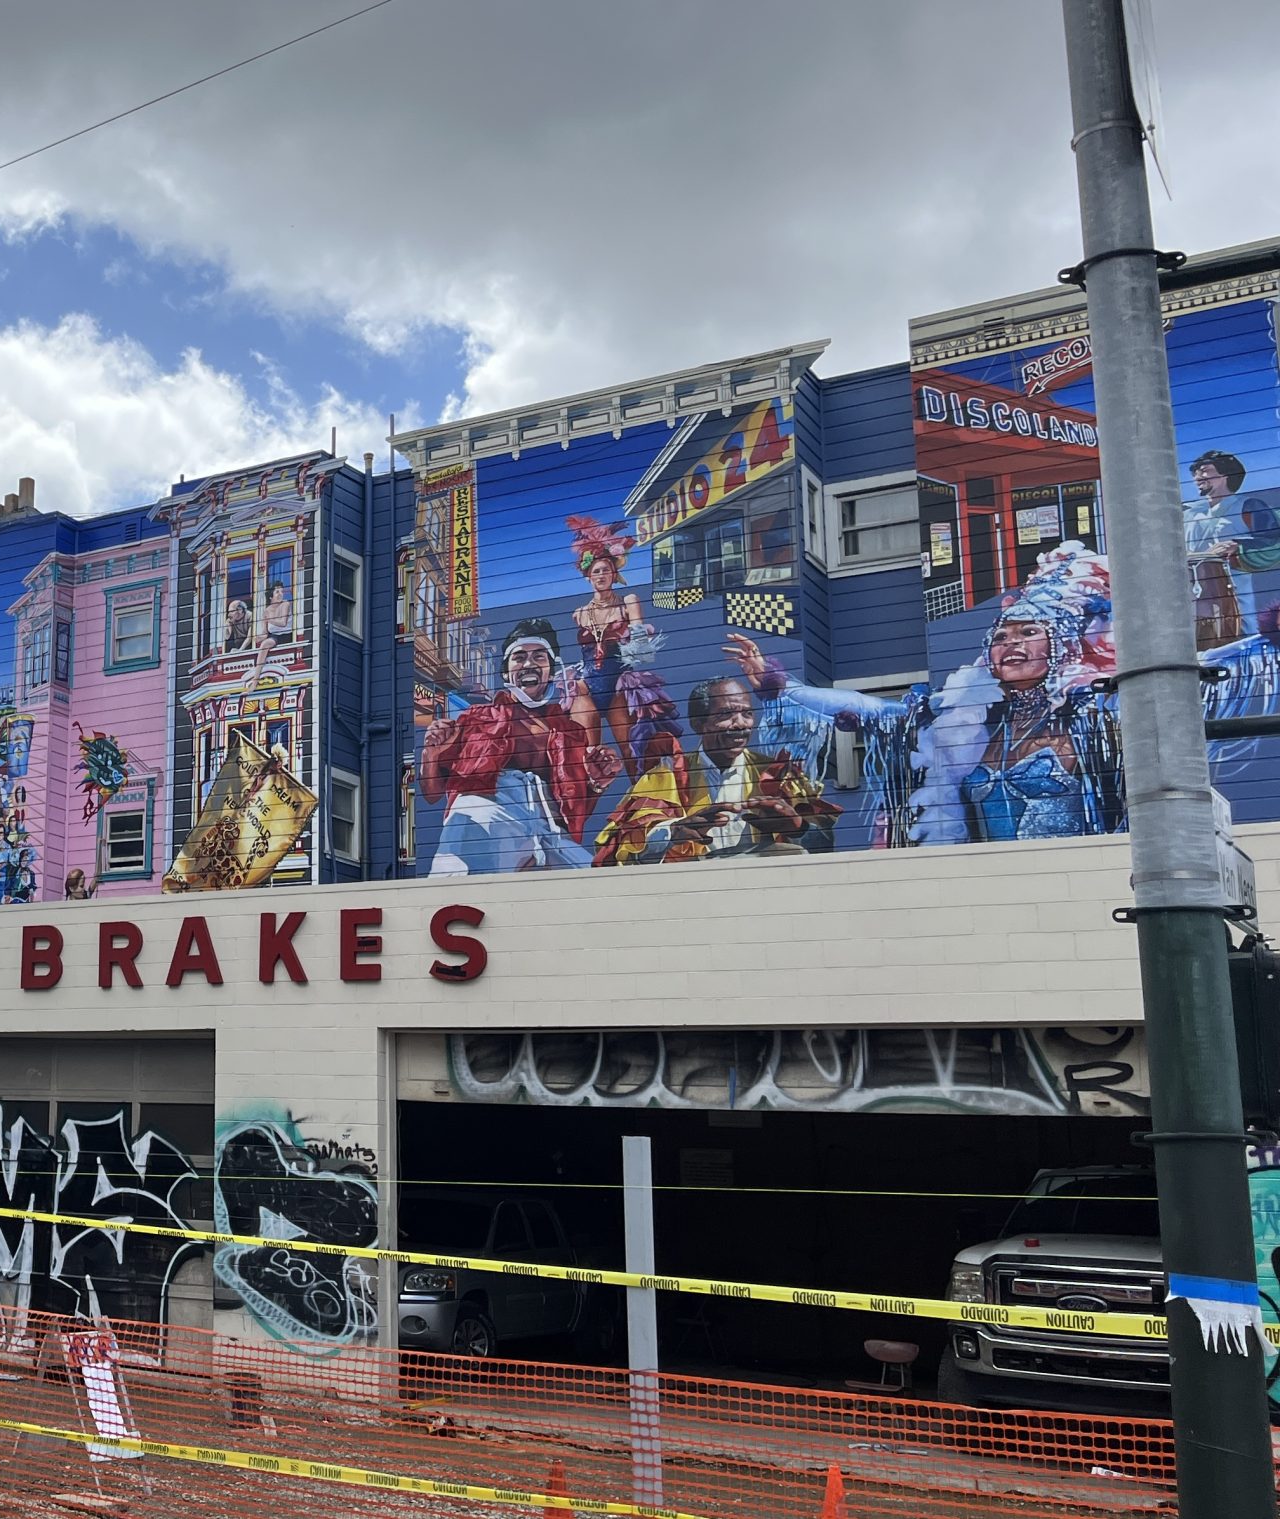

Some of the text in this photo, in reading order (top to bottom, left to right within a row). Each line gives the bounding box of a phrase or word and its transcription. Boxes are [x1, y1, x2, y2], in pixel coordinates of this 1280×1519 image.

[1022, 336, 1091, 384] RECO
[922, 385, 1099, 447] DISCOLAND
[637, 401, 792, 543] STUDIO 24
[455, 487, 471, 597] RESTAURANT
[454, 598, 472, 607] FOOD
[454, 604, 472, 614] TO GO
[236, 755, 298, 811] GOLD DREAM
[255, 796, 271, 817] THE
[246, 809, 271, 839] WORLD
[20, 904, 488, 991] BRAKES
[377, 1251, 411, 1263] CUIDADO
[435, 1257, 469, 1269] CAUTION
[502, 1263, 539, 1277] CUIDADO
[565, 1269, 603, 1284] CAUTION
[640, 1276, 680, 1292] CUIDADO
[709, 1283, 751, 1299] CAUTION
[792, 1290, 836, 1307] CUIDADO
[869, 1297, 915, 1315] CAUTION
[960, 1305, 1009, 1323] CUIDADO
[1045, 1312, 1095, 1331] CAUTION
